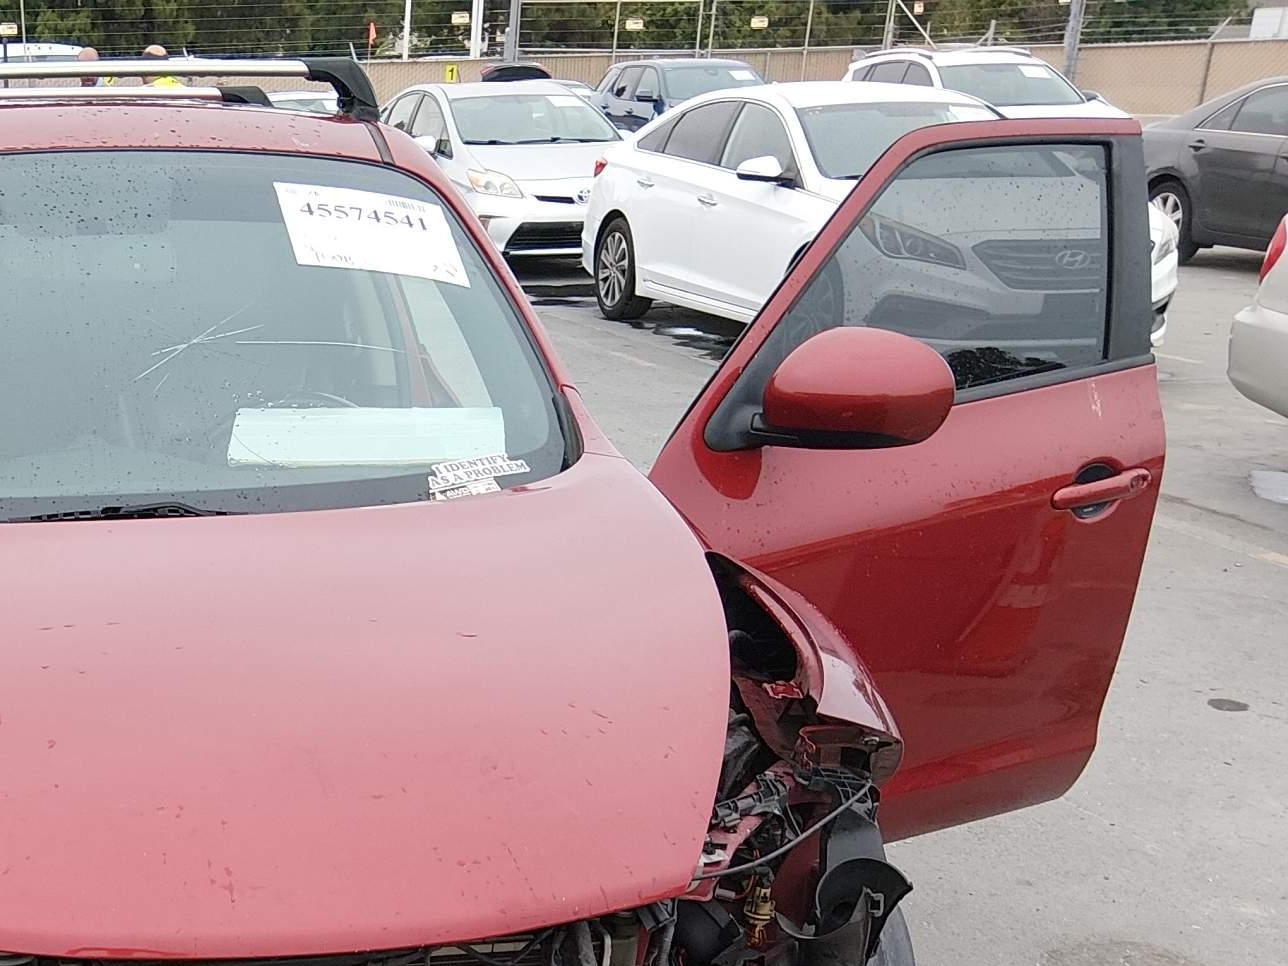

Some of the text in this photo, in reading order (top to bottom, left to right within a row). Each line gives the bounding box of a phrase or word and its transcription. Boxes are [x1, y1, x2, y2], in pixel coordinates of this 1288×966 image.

[448, 67, 455, 80] 1
[299, 202, 428, 231] 45574541
[442, 454, 507, 473] IDENTIFY
[430, 462, 528, 488] AS A PROBLEM
